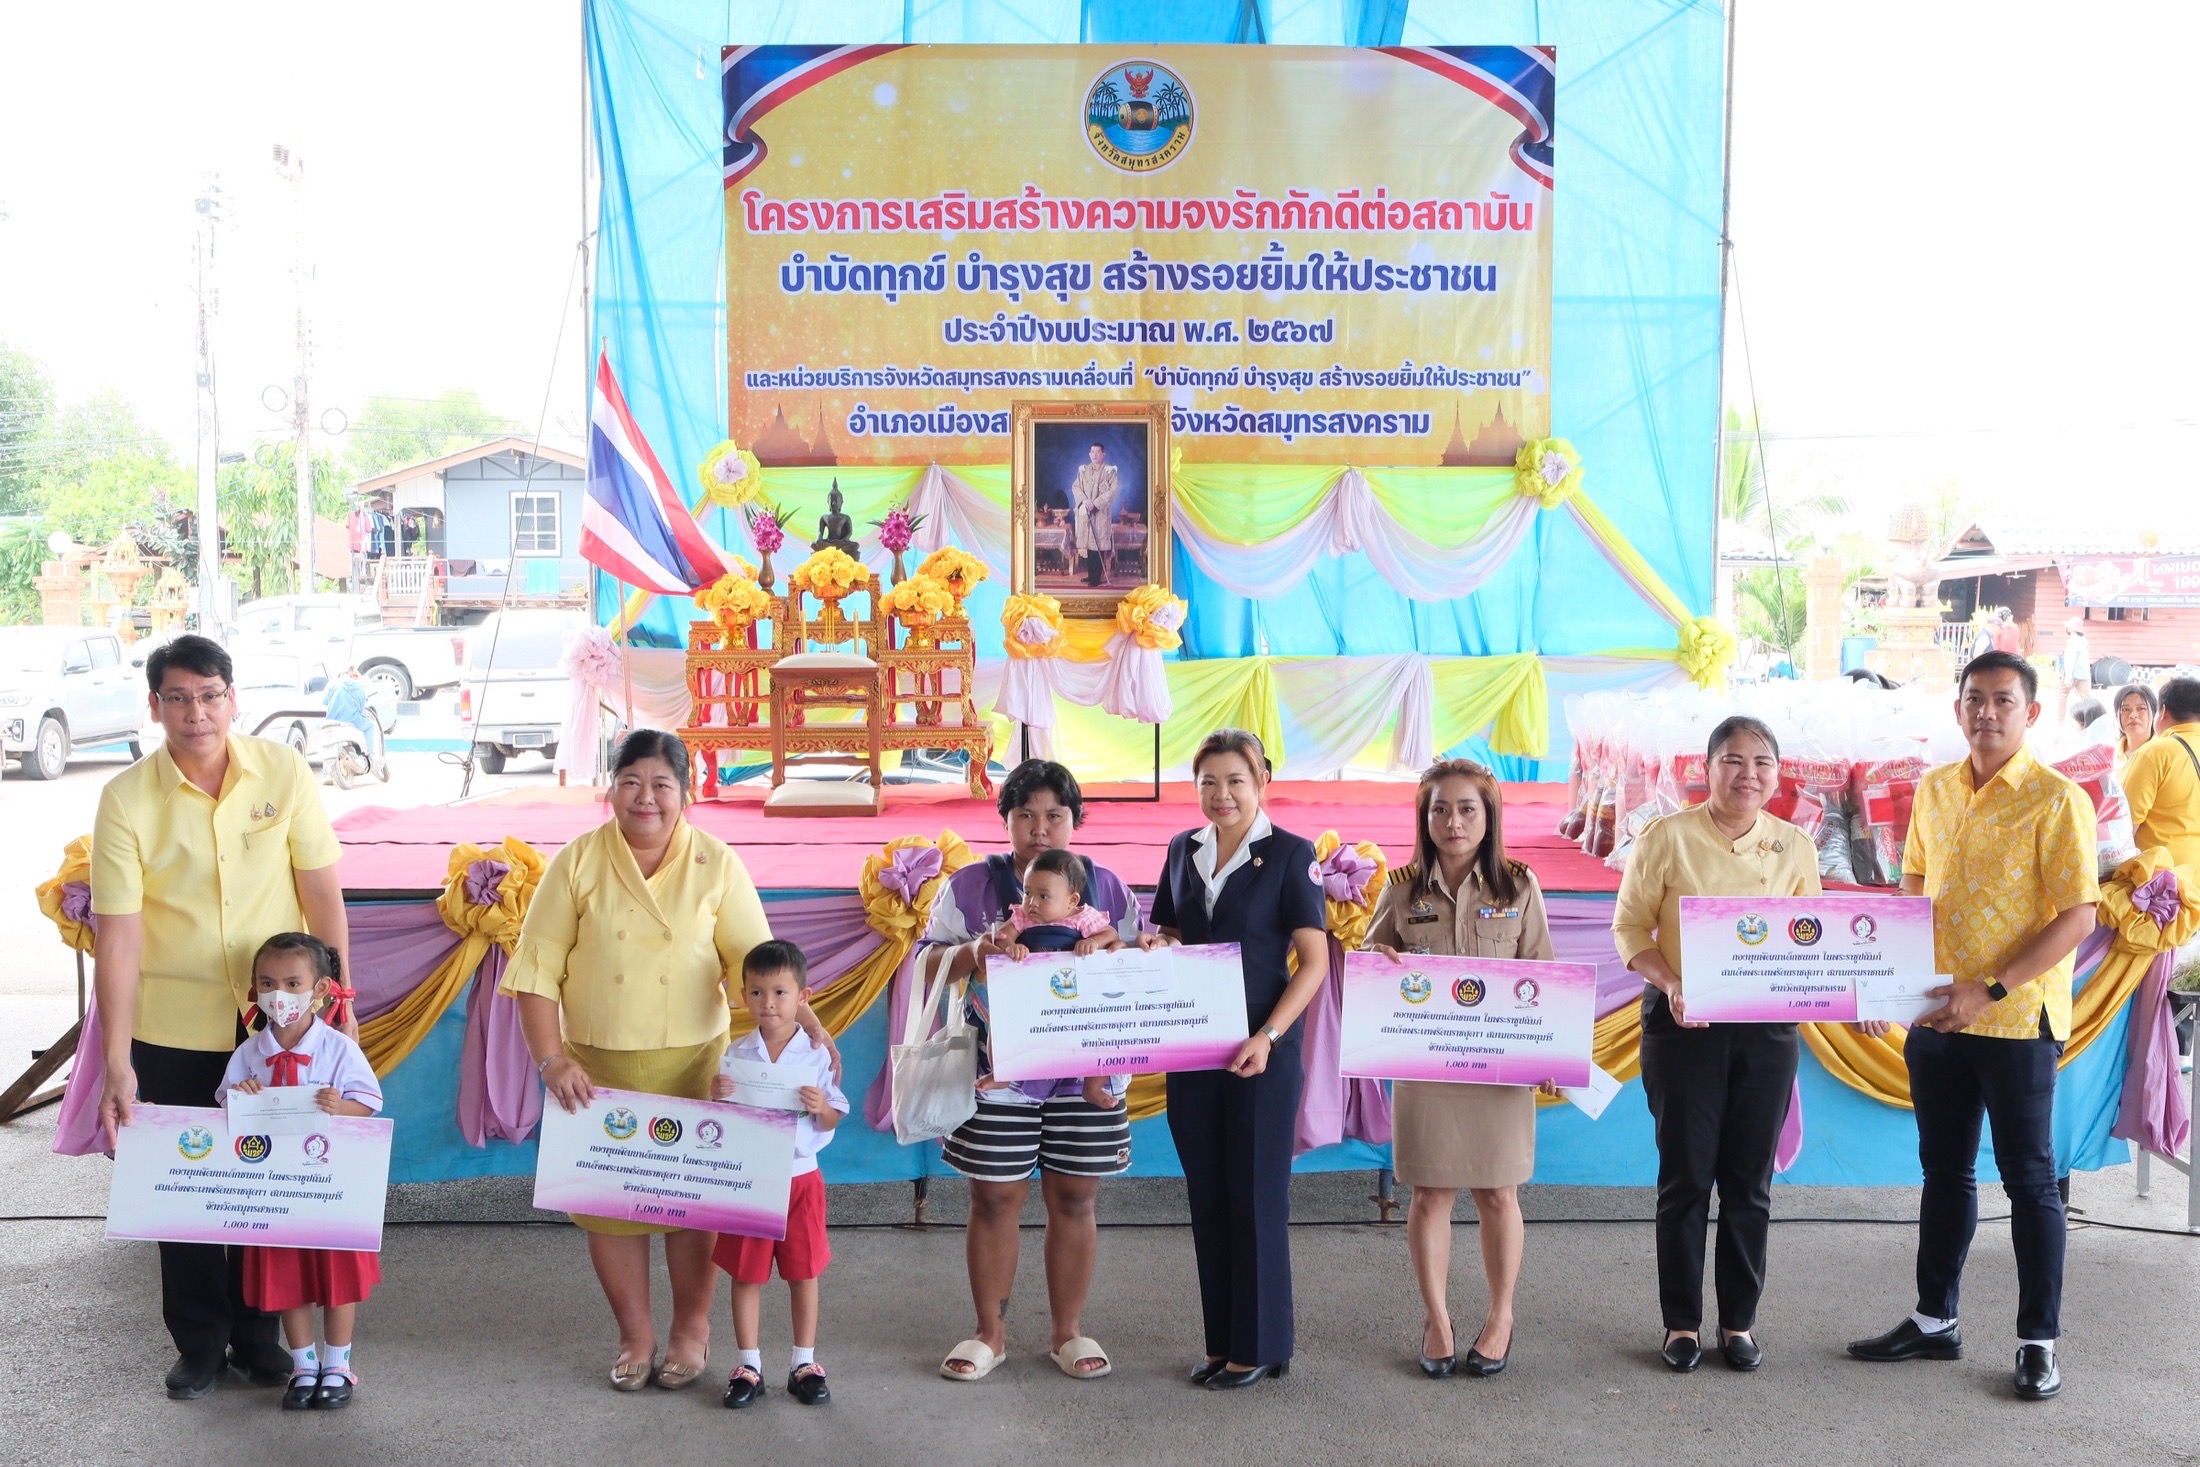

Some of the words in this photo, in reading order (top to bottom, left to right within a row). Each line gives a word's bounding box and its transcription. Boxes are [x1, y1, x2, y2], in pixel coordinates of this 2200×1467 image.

[745, 186, 1533, 231] โครงการเสริมสร้างความจงรักภักดีต่อสถาบัน
[781, 253, 947, 302] บำบัดทุกข์
[958, 252, 1091, 302] บำรุงสุข
[1103, 242, 1496, 292] สร้างรอยยิ้มให้ประชาชน
[945, 313, 1174, 343] ประจำปีงบประมาณ
[1184, 319, 1239, 343] พ.ศ.
[1248, 319, 1333, 343] ๒๕๖๗
[747, 362, 1133, 391] และหน่วยบริการจังหวัดสมุทรสงครามเคลื่อนที่
[1245, 366, 1313, 391] บำรุงสุข
[849, 404, 1012, 434] อำเภอเมืองส
[1171, 406, 1429, 441] จังหวัดสมุทรสงคราม
